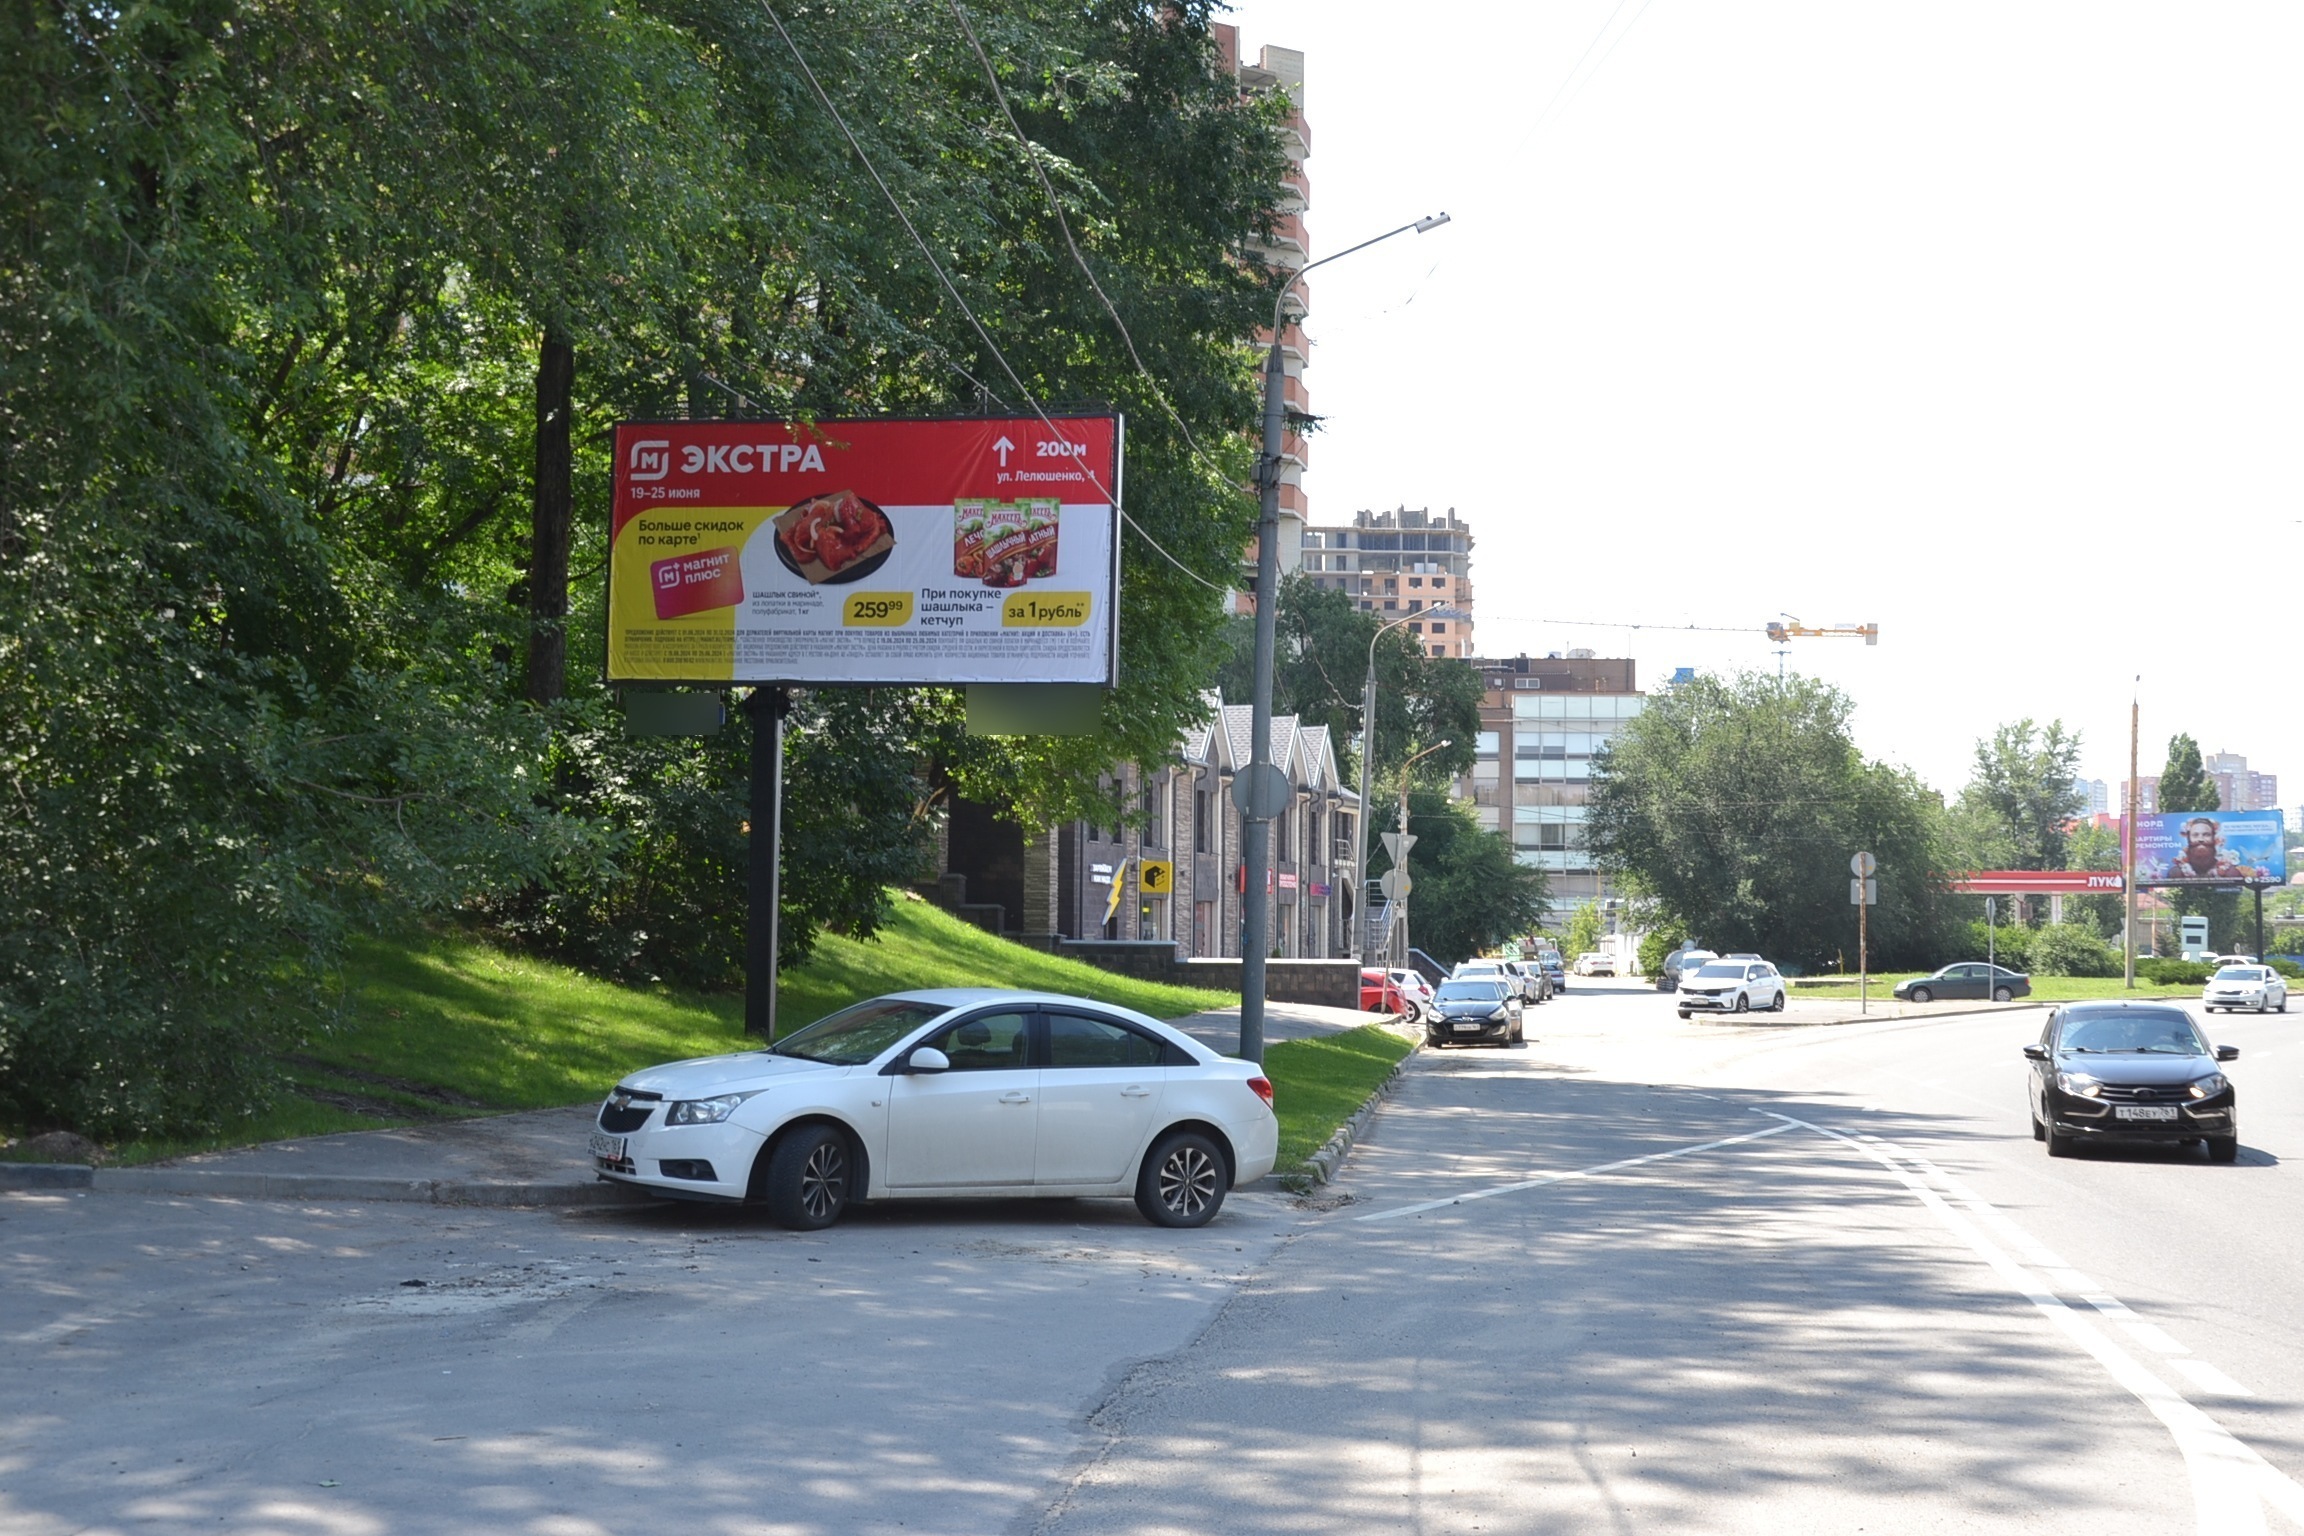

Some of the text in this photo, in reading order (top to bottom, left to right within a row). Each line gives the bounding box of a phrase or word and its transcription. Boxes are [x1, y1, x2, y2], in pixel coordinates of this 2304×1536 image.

[680, 444, 826, 474] ЭКСТРА
[997, 472, 1013, 484] ул.
[1015, 470, 1085, 483] Лелюшенко,
[668, 488, 701, 499] июня
[639, 519, 744, 532] Больше скидок
[638, 535, 656, 546] по
[921, 588, 1002, 603] При покупке
[921, 602, 983, 612] шашлыка
[1008, 607, 1025, 618] за
[920, 616, 964, 628] кетчуп
